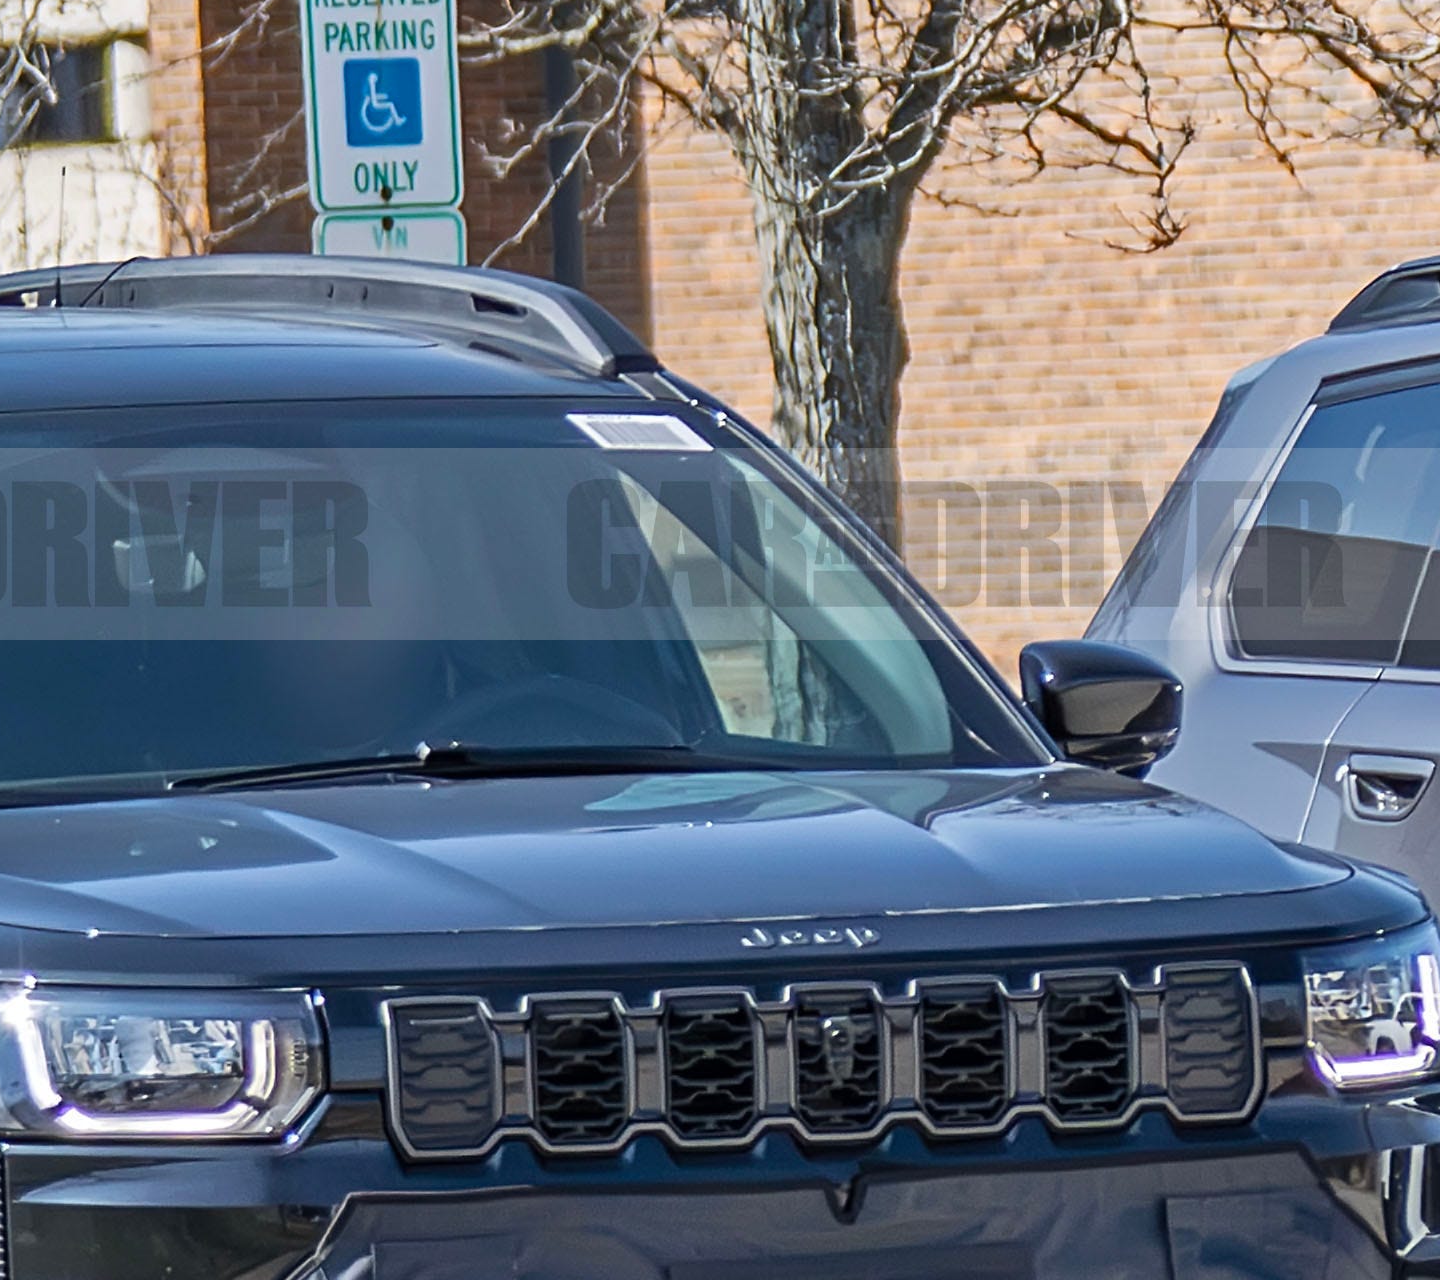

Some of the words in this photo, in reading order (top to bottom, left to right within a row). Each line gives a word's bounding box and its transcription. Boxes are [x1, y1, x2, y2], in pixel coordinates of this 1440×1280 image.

[324, 19, 436, 53] PARKING
[354, 160, 419, 193] ONLY
[740, 927, 881, 949] Jeep
